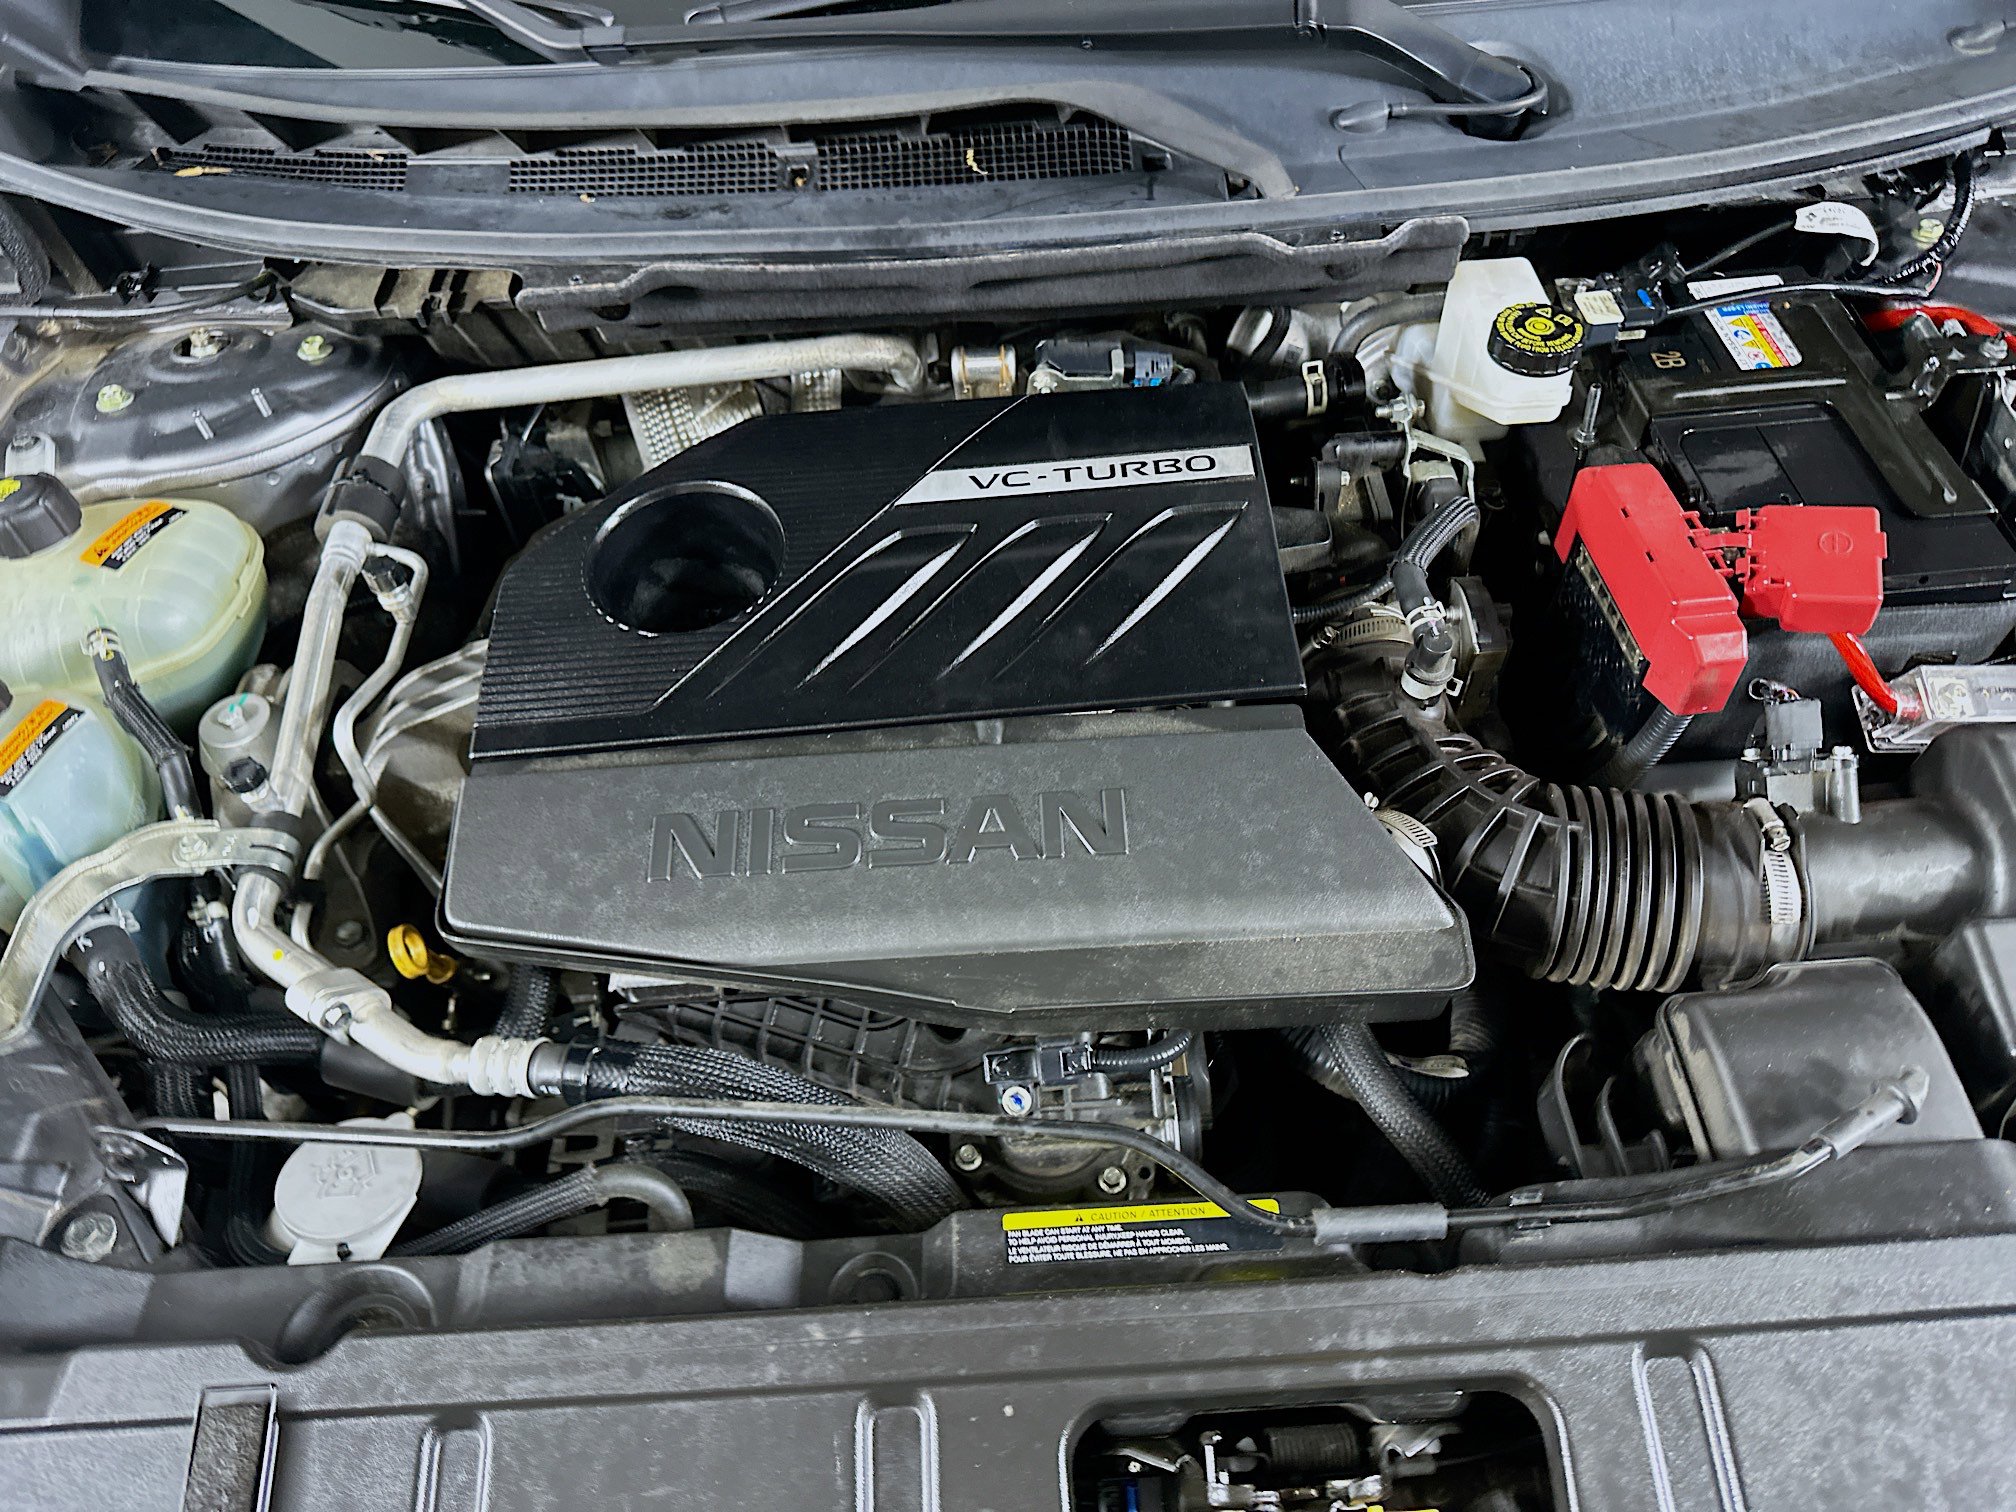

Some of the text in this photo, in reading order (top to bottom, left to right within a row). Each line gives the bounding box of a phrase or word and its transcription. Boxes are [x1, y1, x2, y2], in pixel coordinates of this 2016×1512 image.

[1651, 350, 1686, 369] 2B
[647, 788, 1130, 883] NISSAN
[1091, 1210, 1137, 1221] CAUTION
[1149, 1207, 1206, 1217] ATTENTION
[1008, 1237, 1018, 1246] TO
[1018, 1236, 1036, 1245] HELP
[1037, 1235, 1058, 1244] AVOID
[1008, 1254, 1028, 1263] POUR
